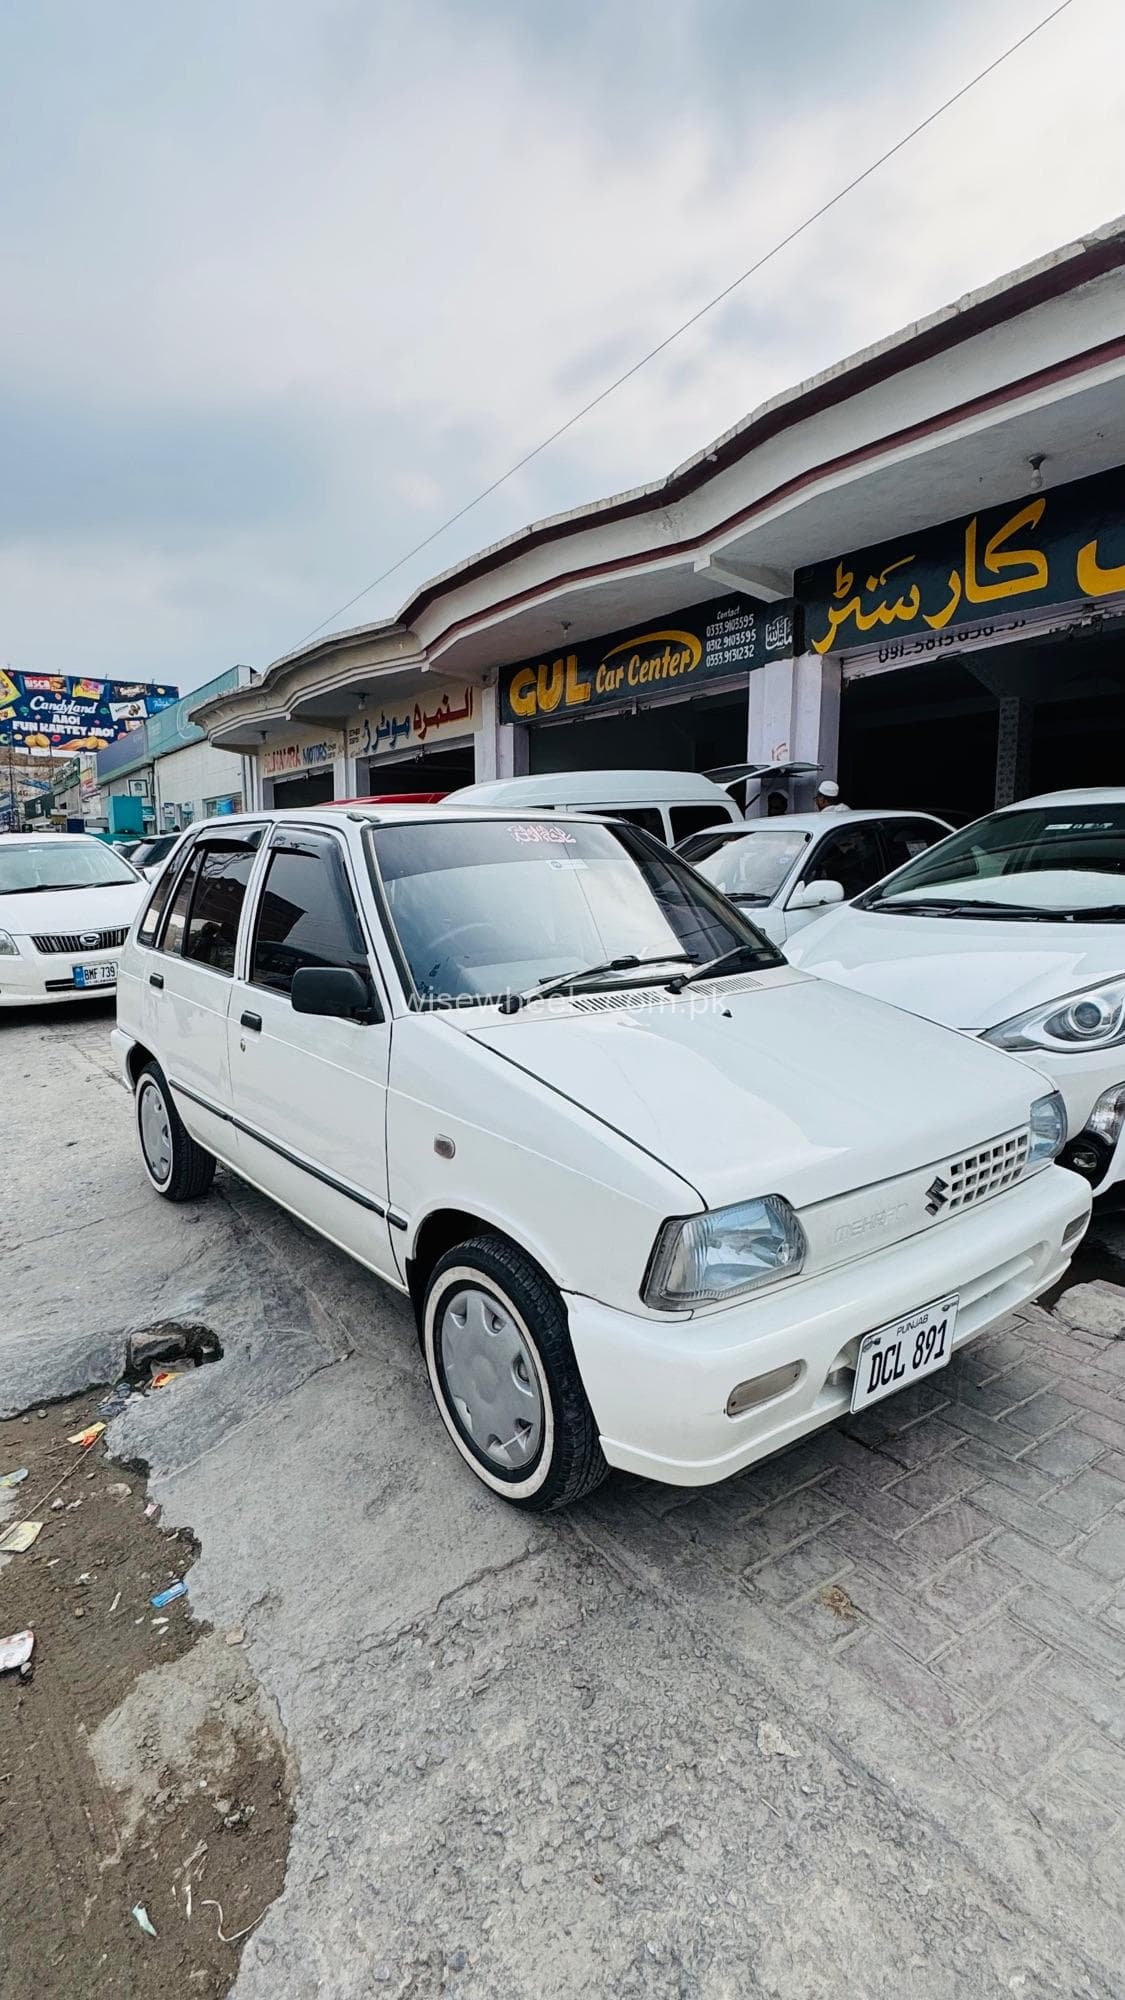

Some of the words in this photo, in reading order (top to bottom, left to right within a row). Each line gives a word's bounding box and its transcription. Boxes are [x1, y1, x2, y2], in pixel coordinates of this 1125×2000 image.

[509, 654, 592, 717] GUL
[595, 663, 624, 694] Car
[627, 646, 693, 686] Center
[12, 720, 38, 732] FUN
[39, 722, 87, 736] KARTEY
[84, 968, 98, 981] BMF
[100, 965, 116, 979] 739
[896, 1313, 929, 1336] PUNJAB
[866, 1341, 905, 1394] DCL
[912, 1319, 948, 1370] 891
